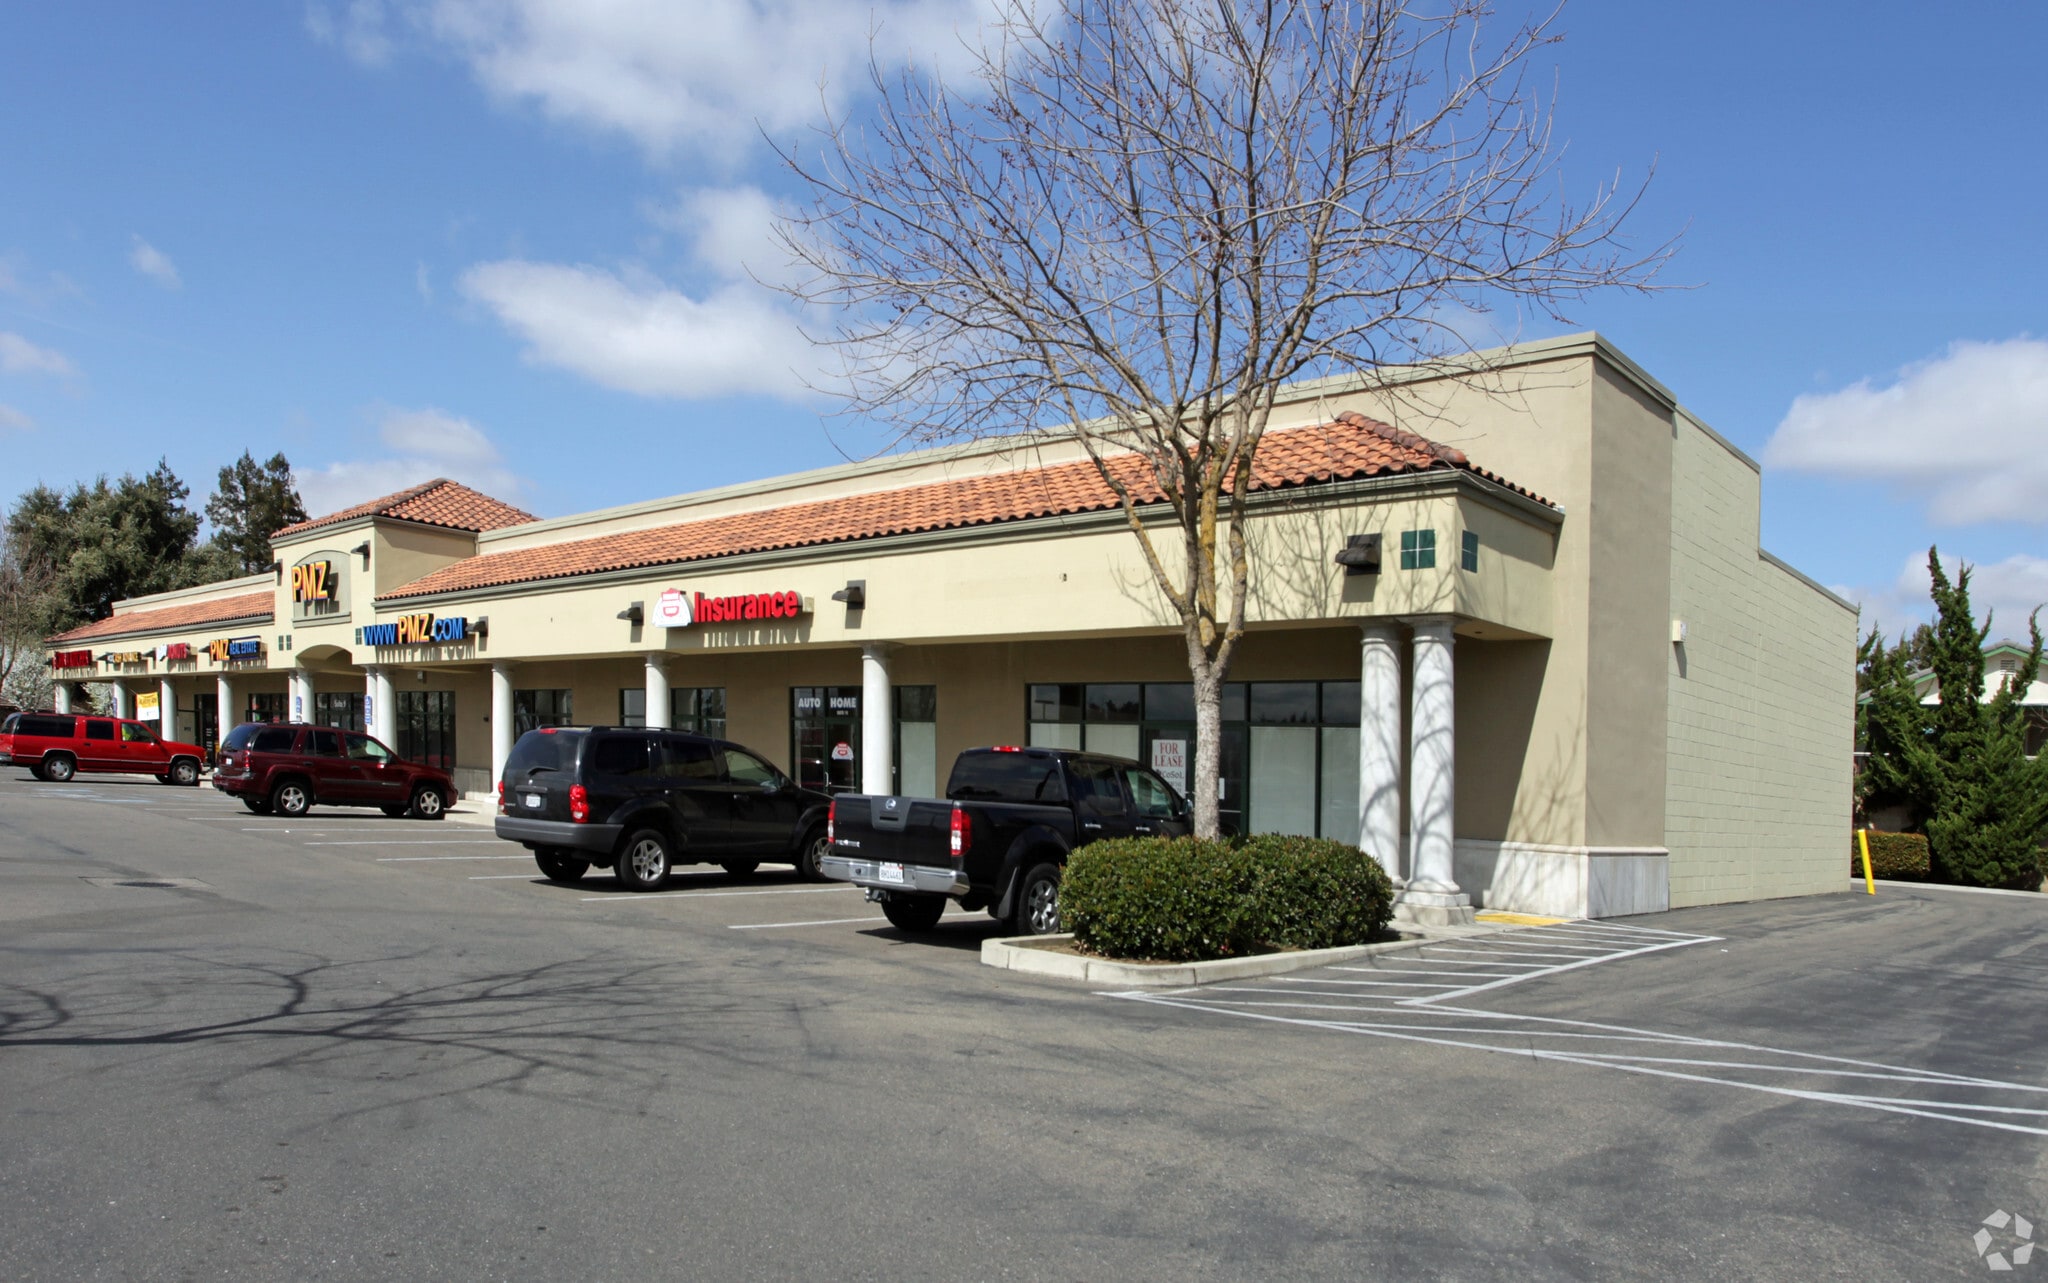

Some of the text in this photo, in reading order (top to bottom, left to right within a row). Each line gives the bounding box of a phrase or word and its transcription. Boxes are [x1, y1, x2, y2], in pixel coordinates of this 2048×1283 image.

[291, 560, 329, 602] PMZ
[693, 590, 799, 623] Insurance
[209, 638, 257, 661] PMZ REAL ESTATE
[798, 697, 857, 708] AUTO HOME
[1159, 743, 1179, 755] FOR
[1154, 755, 1184, 767] LEASE
